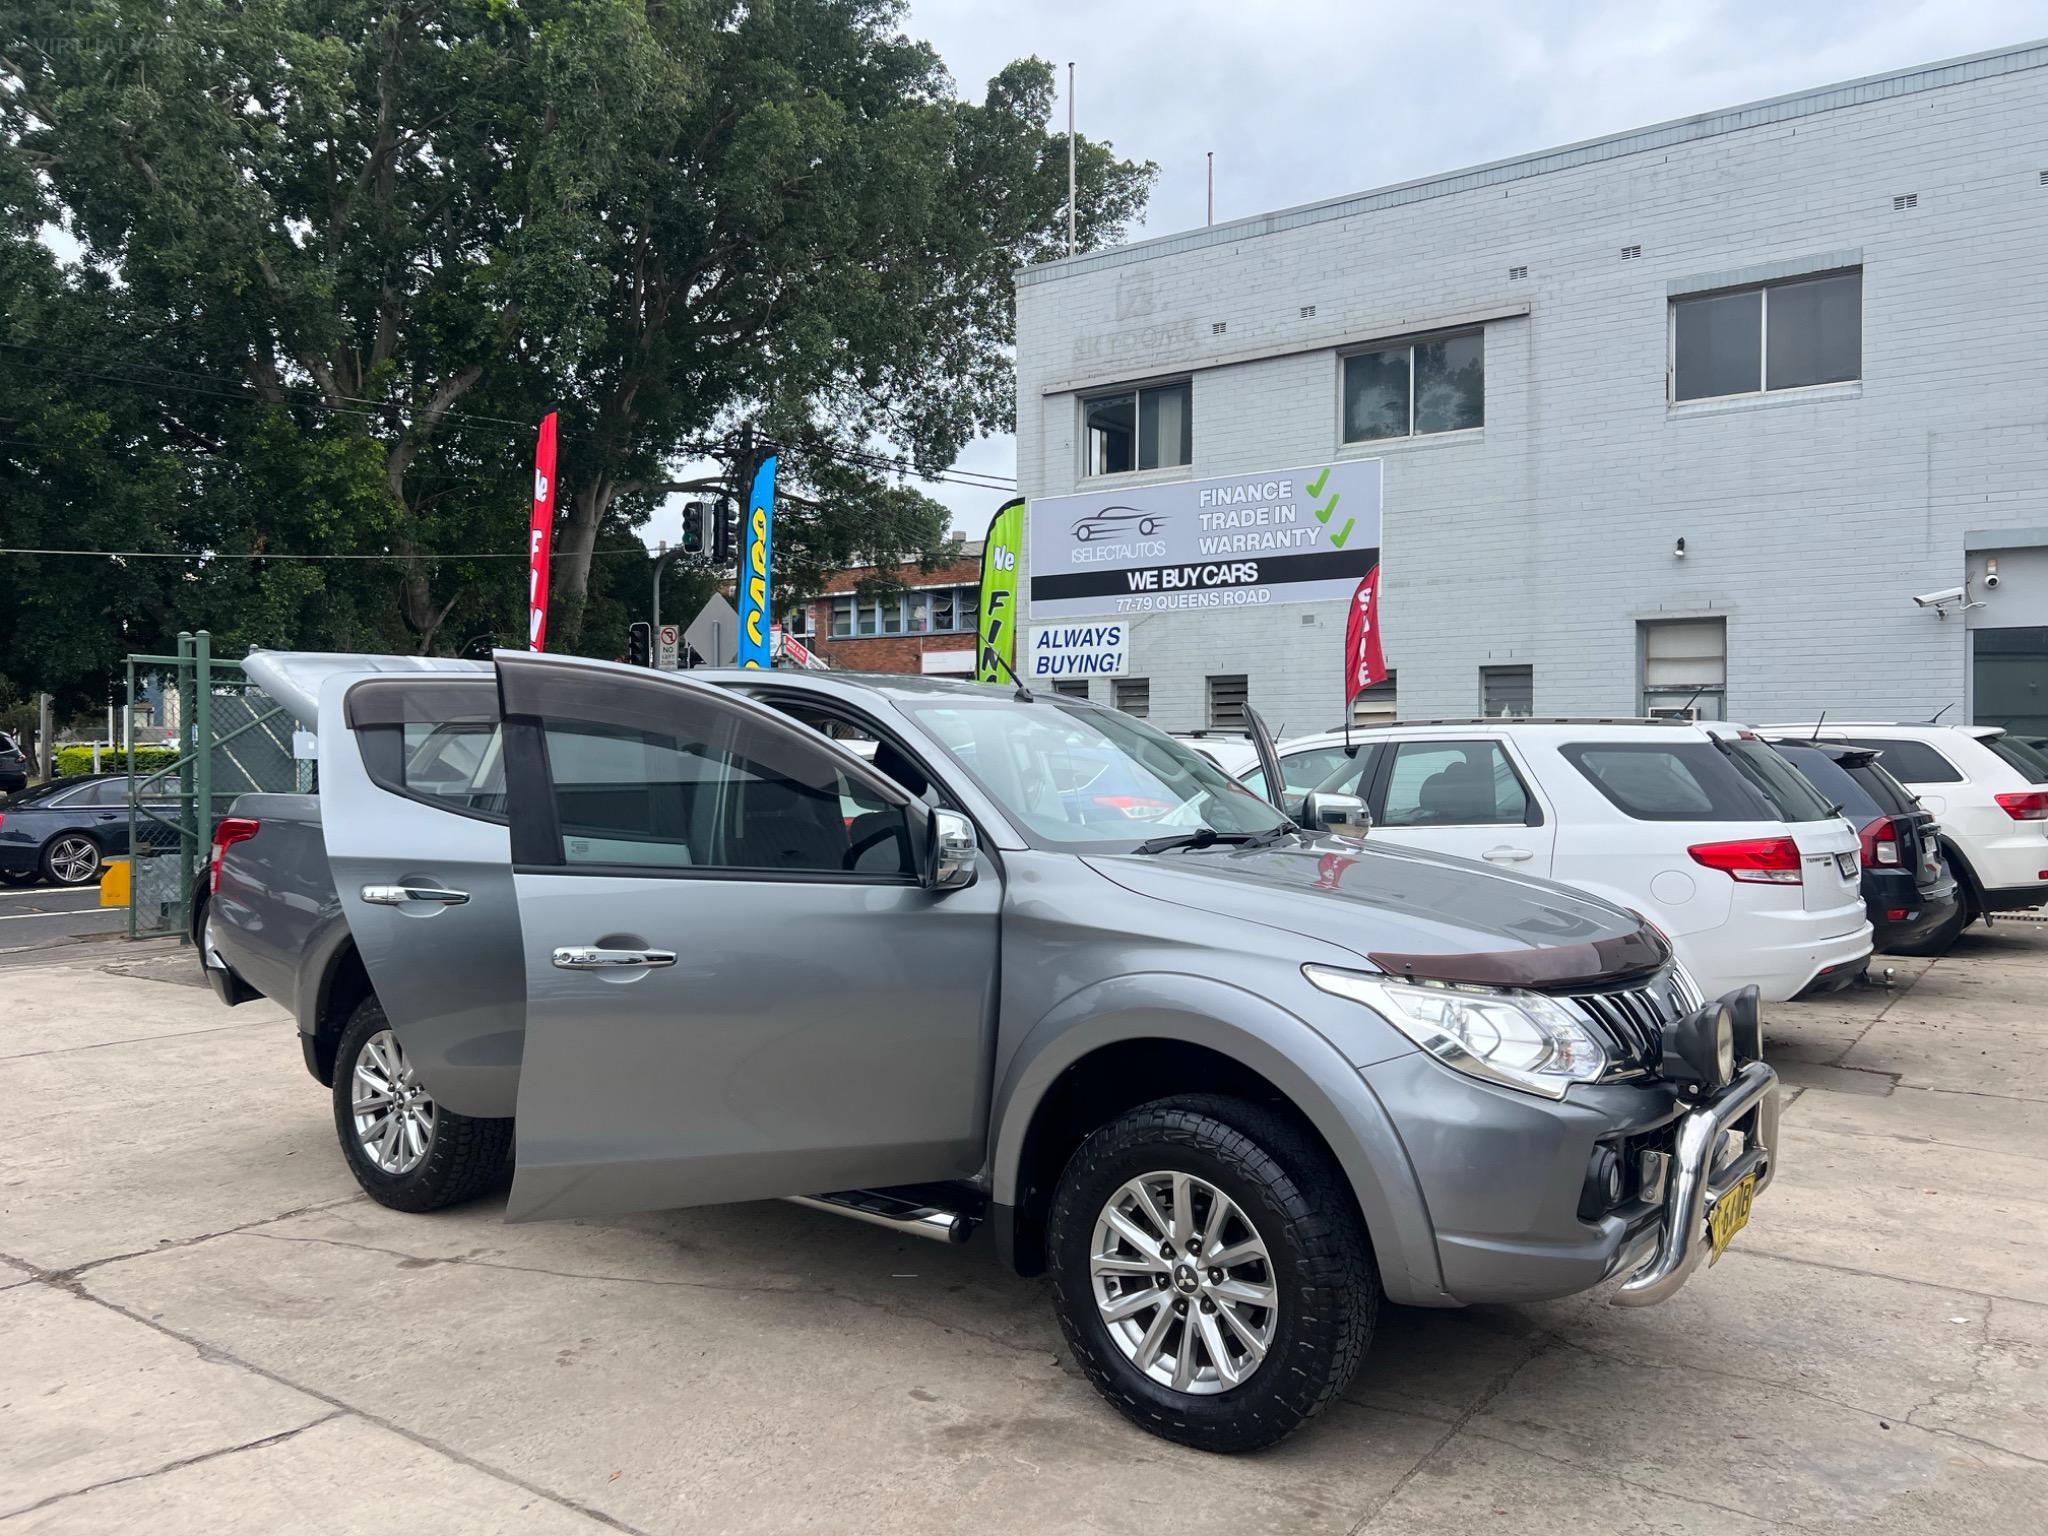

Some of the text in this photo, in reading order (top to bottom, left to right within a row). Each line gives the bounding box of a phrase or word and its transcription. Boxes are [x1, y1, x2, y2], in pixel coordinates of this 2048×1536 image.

[1199, 479, 1293, 508] FINANCE
[1199, 503, 1297, 531] TRADE IN
[1198, 525, 1322, 556] WARRANTY
[1127, 562, 1259, 591] WE BUY CARS
[1116, 588, 1271, 612] 77-79 QUEENS ROAD
[1036, 626, 1122, 649] ALWAYS
[1036, 652, 1122, 675] BUYING!
